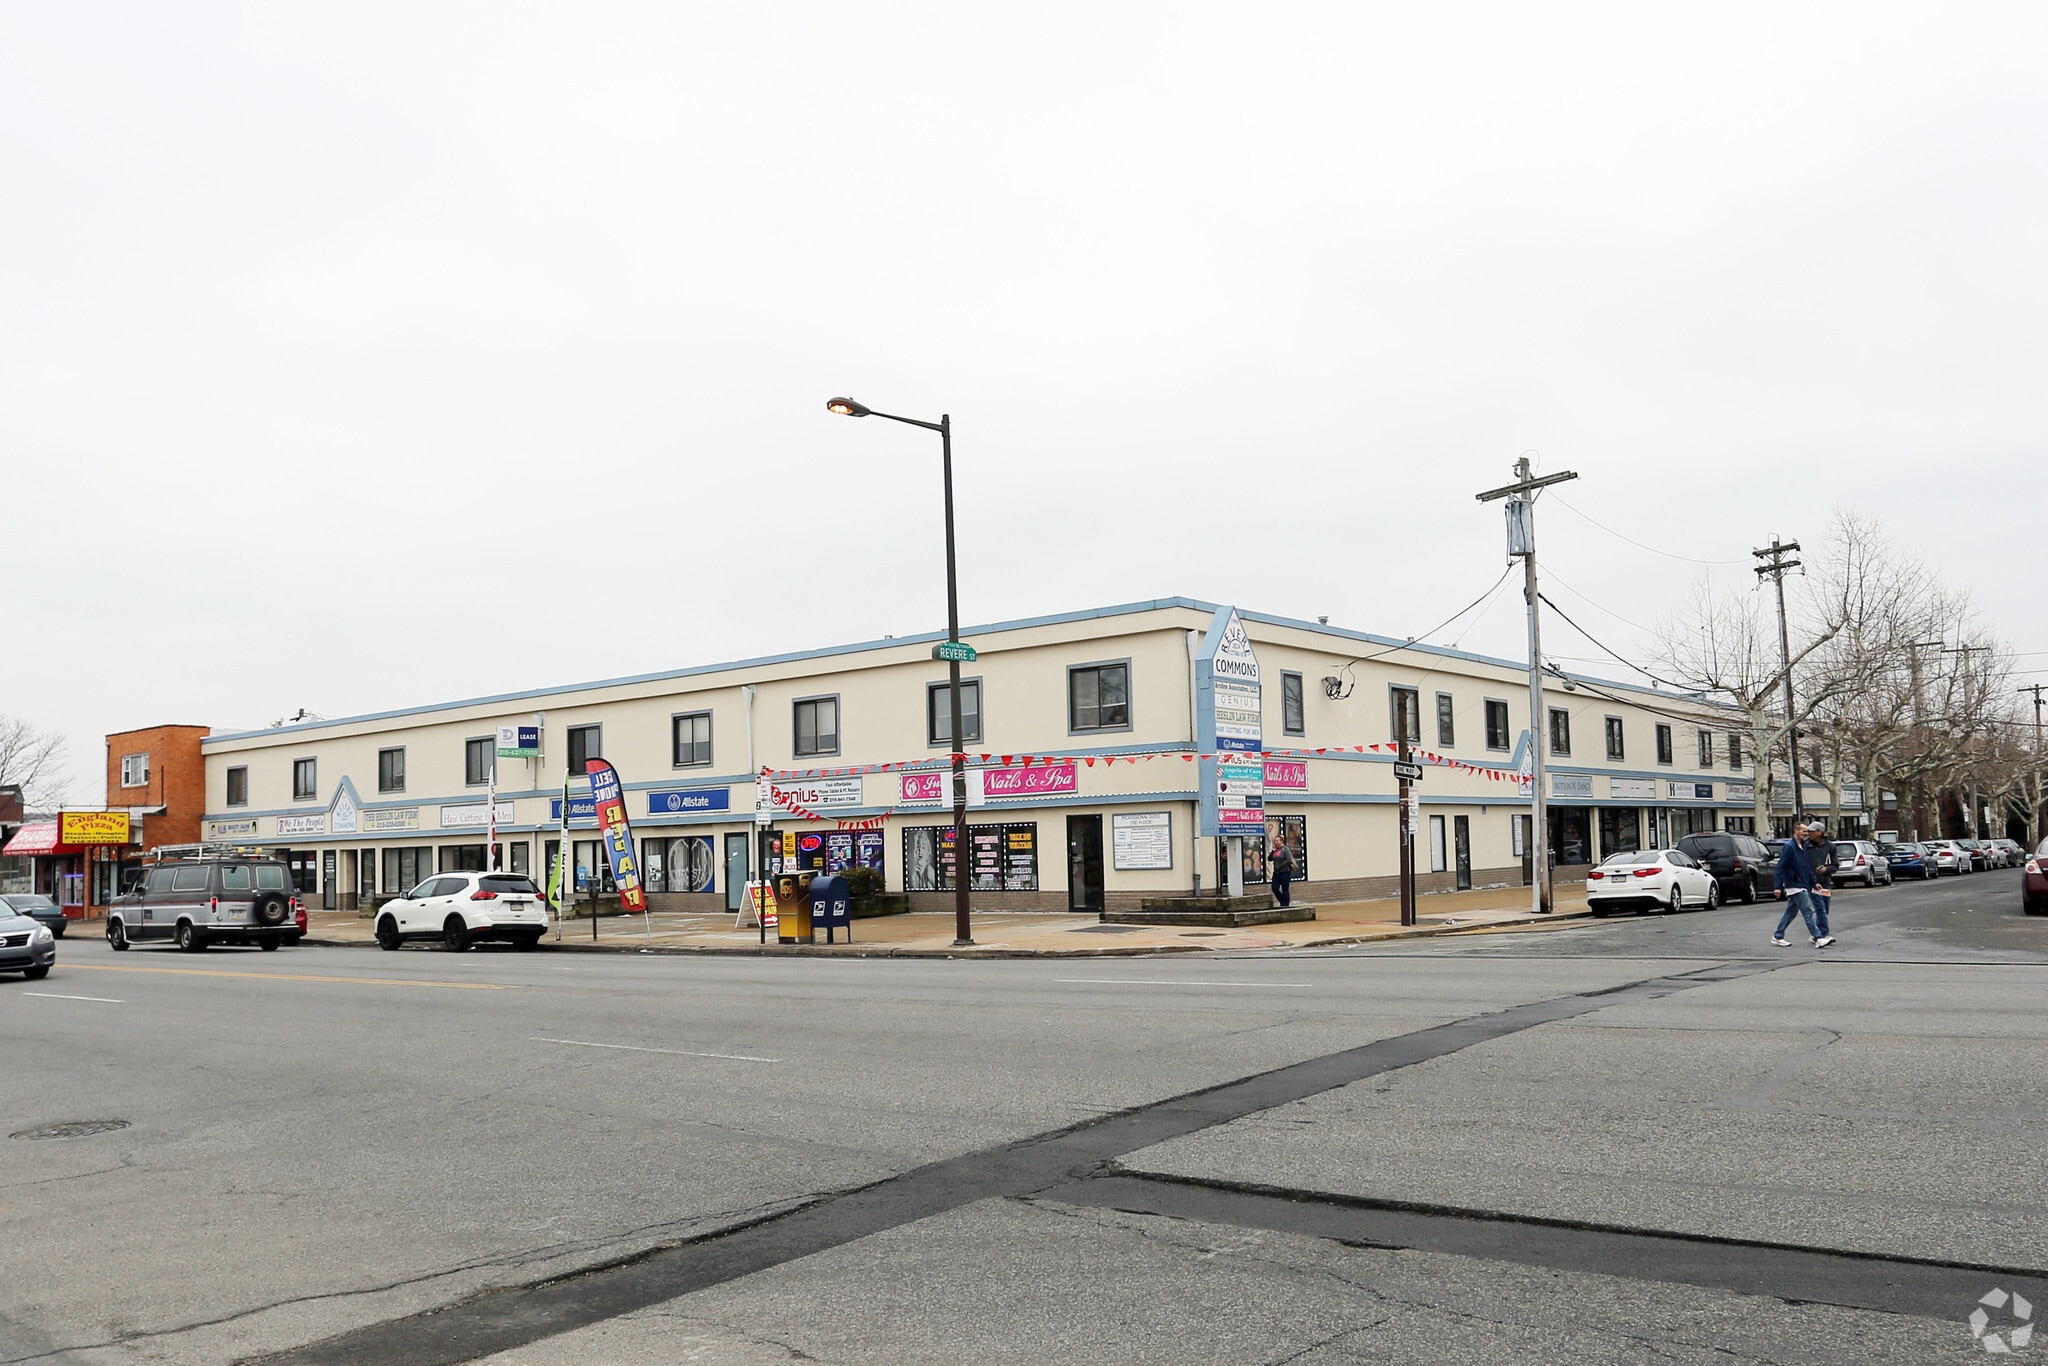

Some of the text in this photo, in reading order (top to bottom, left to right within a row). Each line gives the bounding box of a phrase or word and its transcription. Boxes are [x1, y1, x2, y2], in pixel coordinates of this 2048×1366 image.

[940, 647, 976, 661] REVERE ST
[1215, 659, 1257, 677] COMMONS
[1221, 695, 1254, 707] GENIUS
[984, 768, 1072, 790] Nails & Spa
[1264, 764, 1305, 786] Nails & Spa
[681, 796, 709, 808] Allstate
[571, 804, 595, 814] Allstate
[66, 813, 125, 829] England
[444, 814, 458, 823] Hair
[460, 813, 482, 823] Cutting
[497, 811, 512, 820] Men
[80, 821, 113, 831] Pizza
[293, 819, 304, 827] The
[305, 817, 324, 828] People
[801, 838, 820, 849] OPEN
[754, 888, 770, 898] CEL
